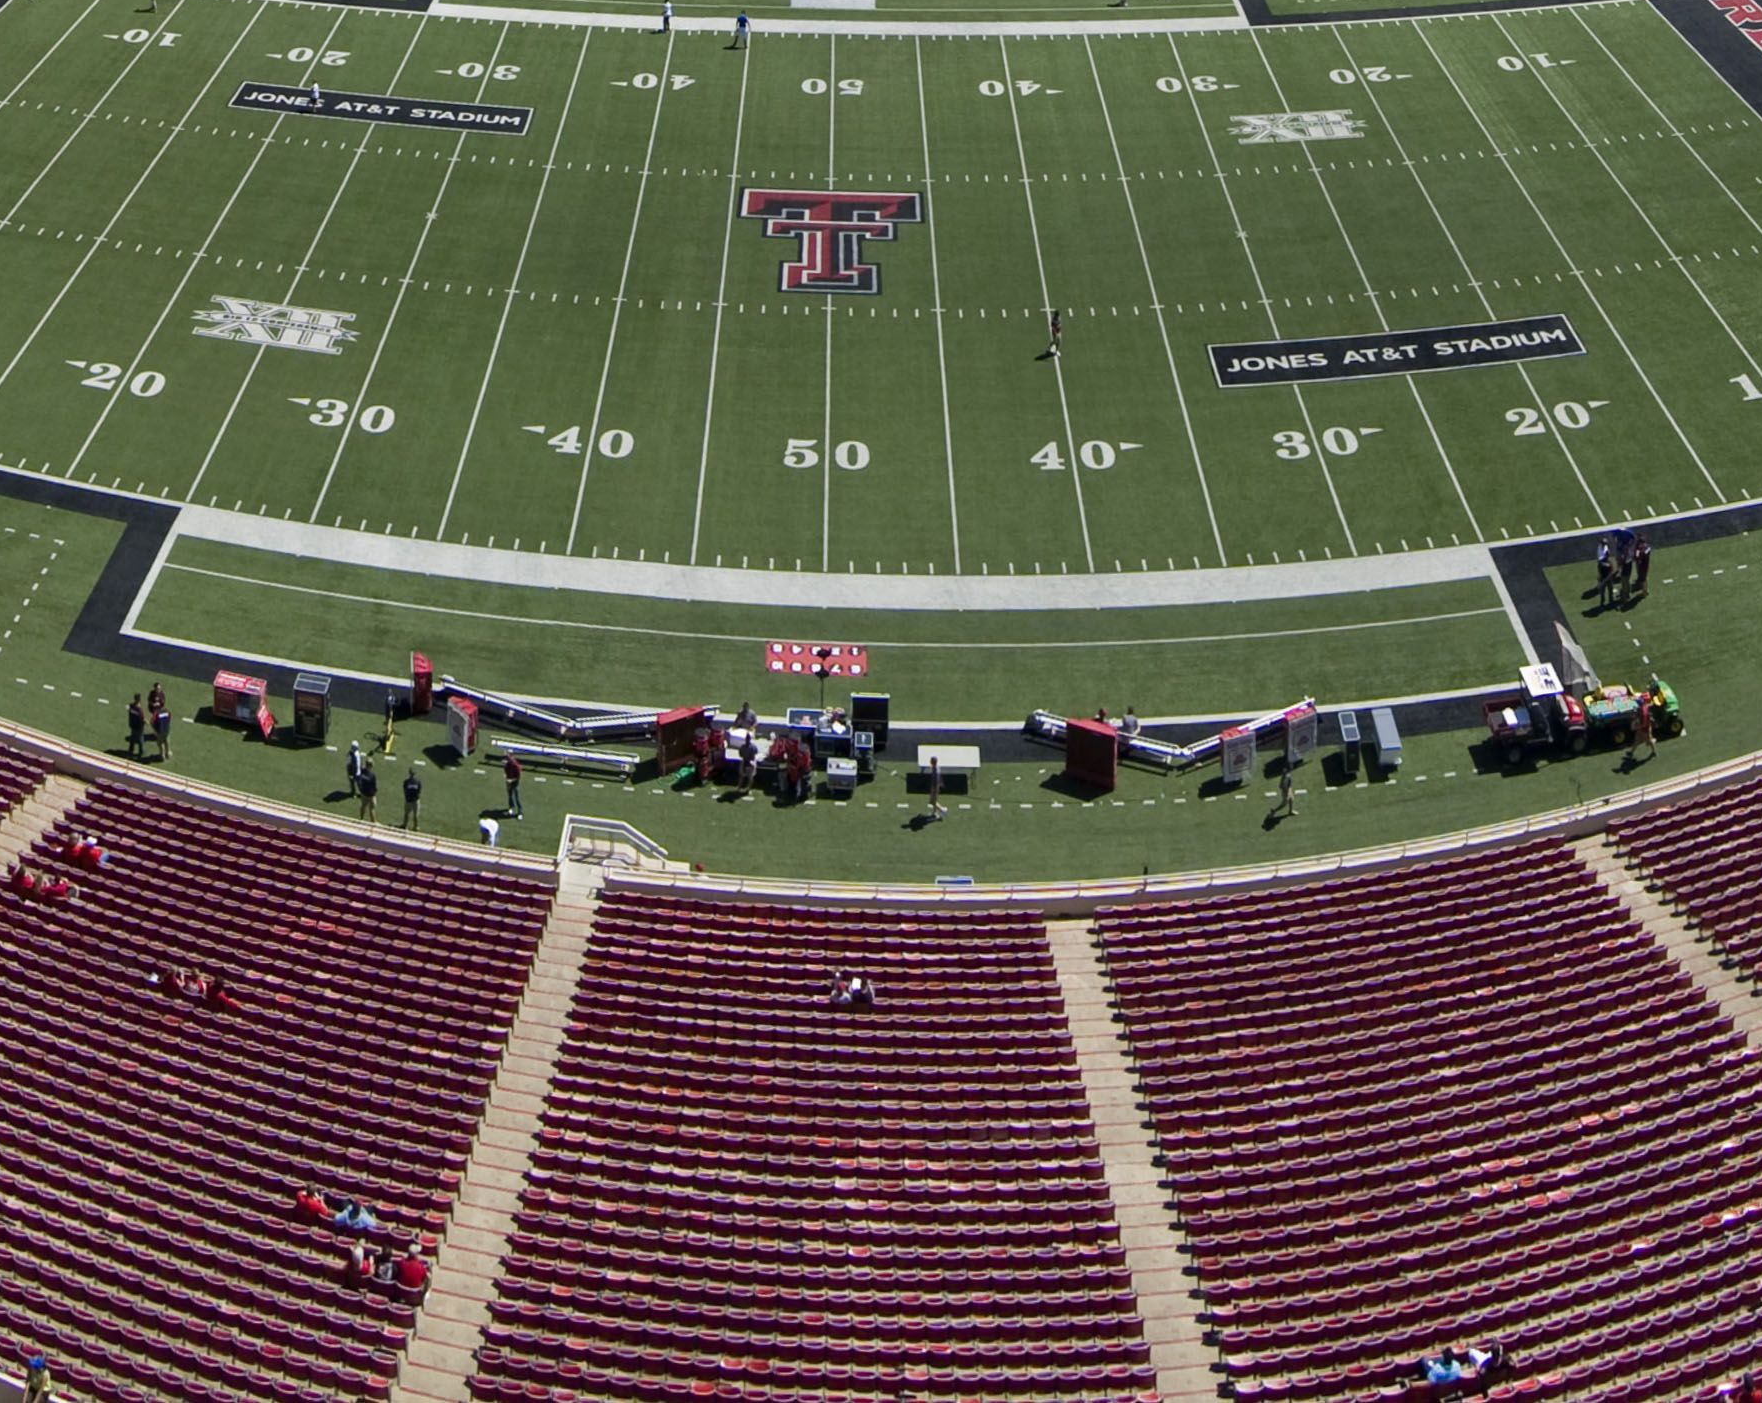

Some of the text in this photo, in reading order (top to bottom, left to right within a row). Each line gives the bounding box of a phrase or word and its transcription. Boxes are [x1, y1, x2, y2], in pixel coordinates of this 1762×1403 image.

[121, 26, 182, 48] 10
[287, 47, 351, 66] 20
[1497, 51, 1562, 72] 10
[456, 62, 523, 81] 30
[632, 73, 696, 91] 40
[1328, 65, 1394, 85] 20
[801, 78, 864, 96] 50
[978, 79, 1043, 97] 40
[1156, 75, 1220, 93] 30
[334, 100, 401, 116] AT&T
[409, 107, 522, 126] STADIUM
[1226, 328, 1567, 373] JONES AT&T STADIUM
[84, 362, 167, 398] 20
[309, 399, 396, 435] 30
[1504, 400, 1593, 437] 20
[546, 426, 635, 460] 40
[783, 438, 871, 471] 50
[1029, 438, 1118, 471] 40
[1272, 426, 1361, 461] 30
